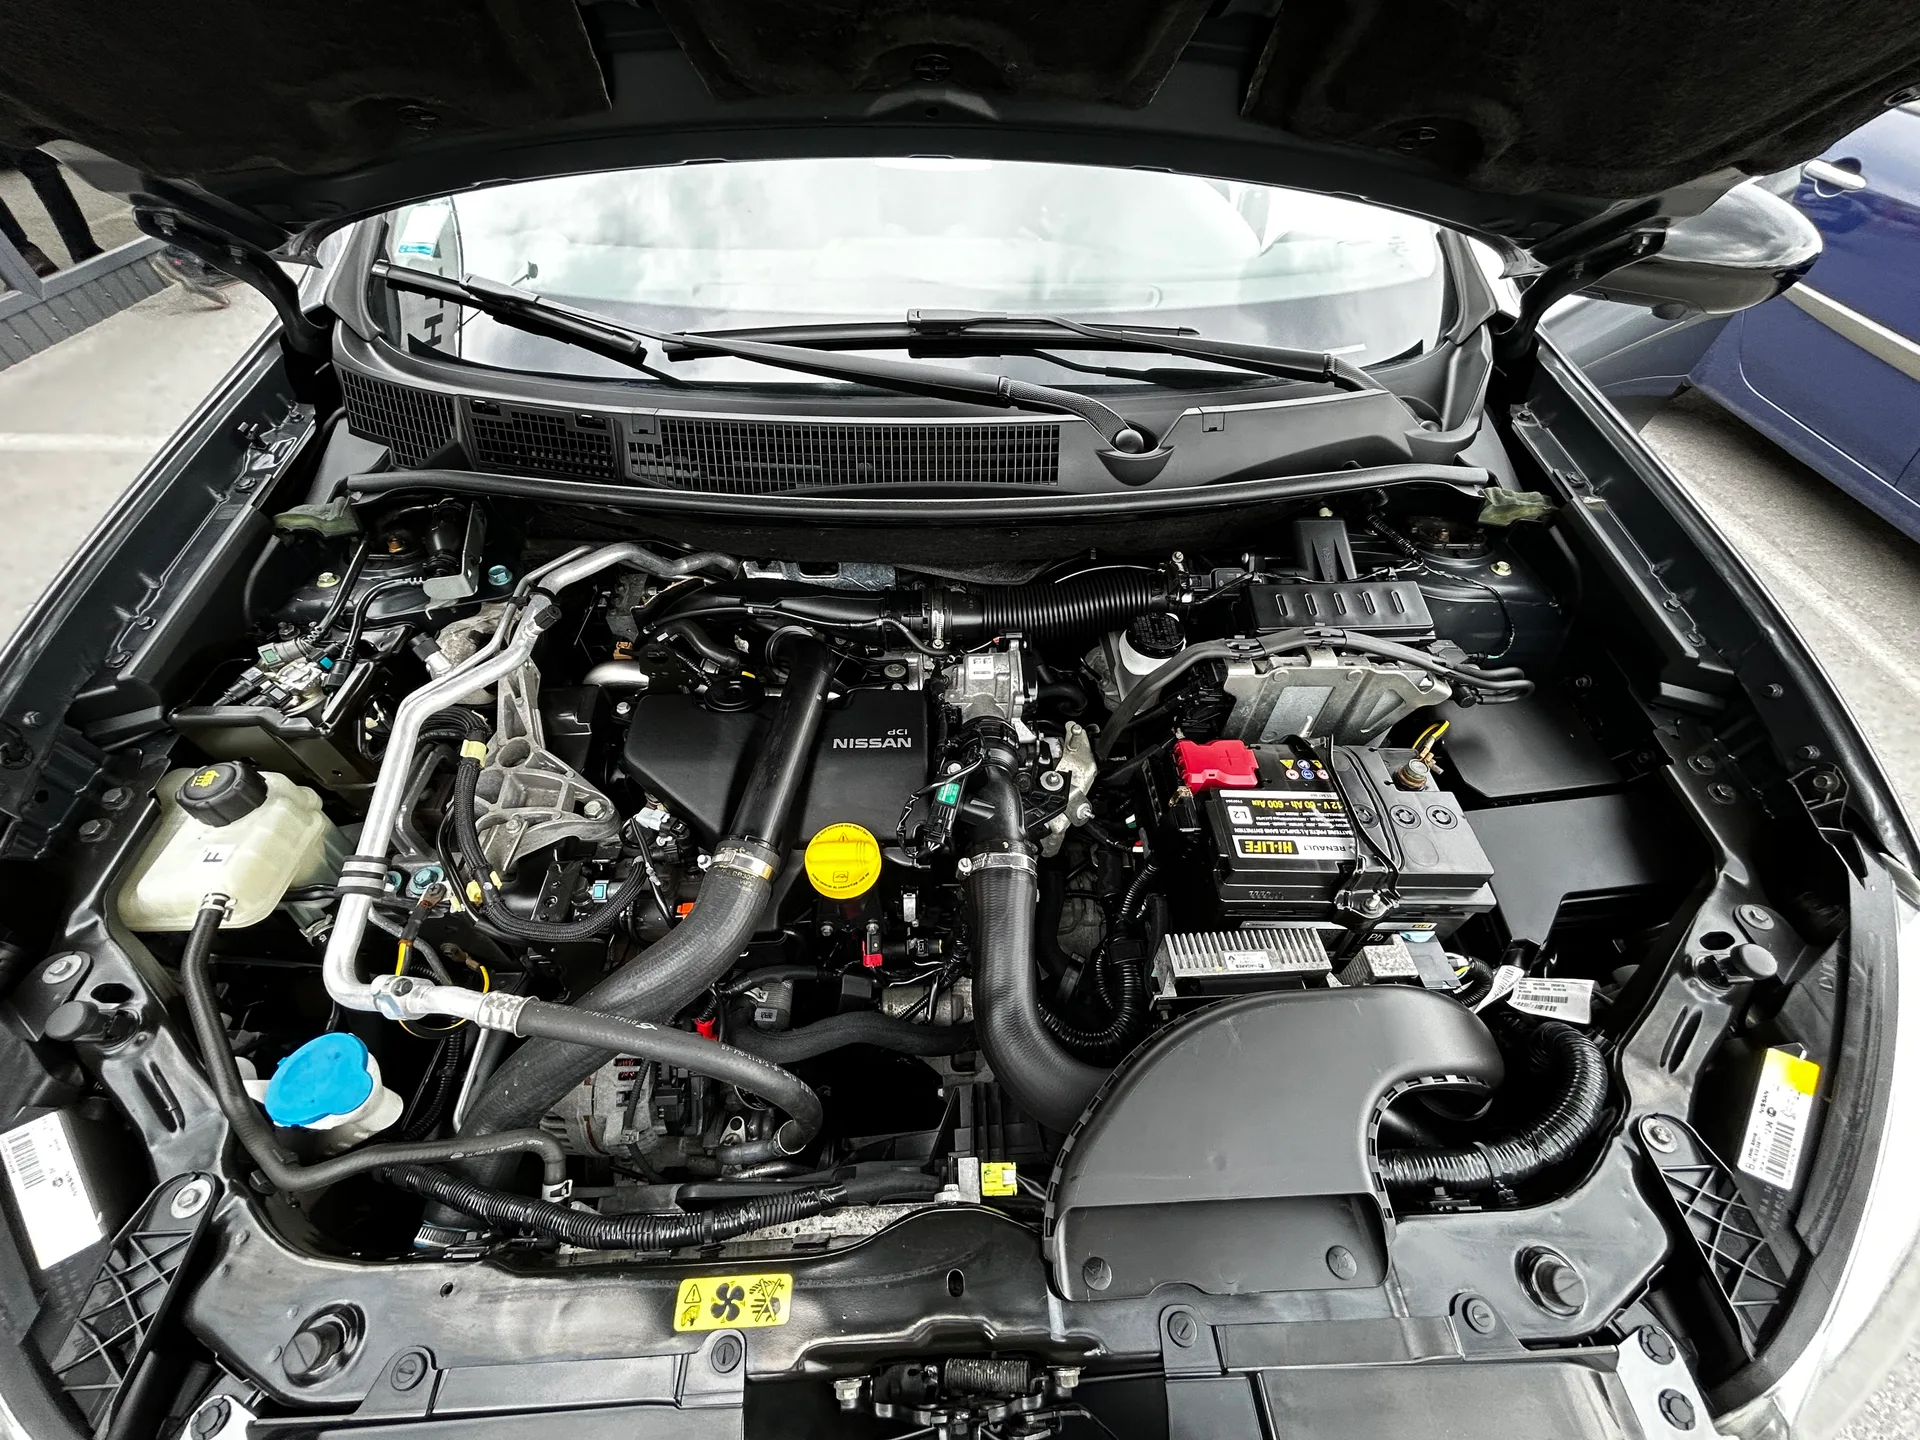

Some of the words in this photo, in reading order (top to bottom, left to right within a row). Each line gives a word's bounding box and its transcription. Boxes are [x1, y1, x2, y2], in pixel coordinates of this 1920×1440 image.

[832, 737, 912, 749] NISSAN
[1268, 799, 1284, 808] 600
[1291, 800, 1303, 808] Ah
[1323, 801, 1331, 809] V
[1331, 801, 1343, 810] 12
[1233, 810, 1247, 819] L2
[1303, 844, 1346, 853] RENAULT
[1367, 932, 1385, 942] Pb
[1758, 1090, 1769, 1115] NISSAN
